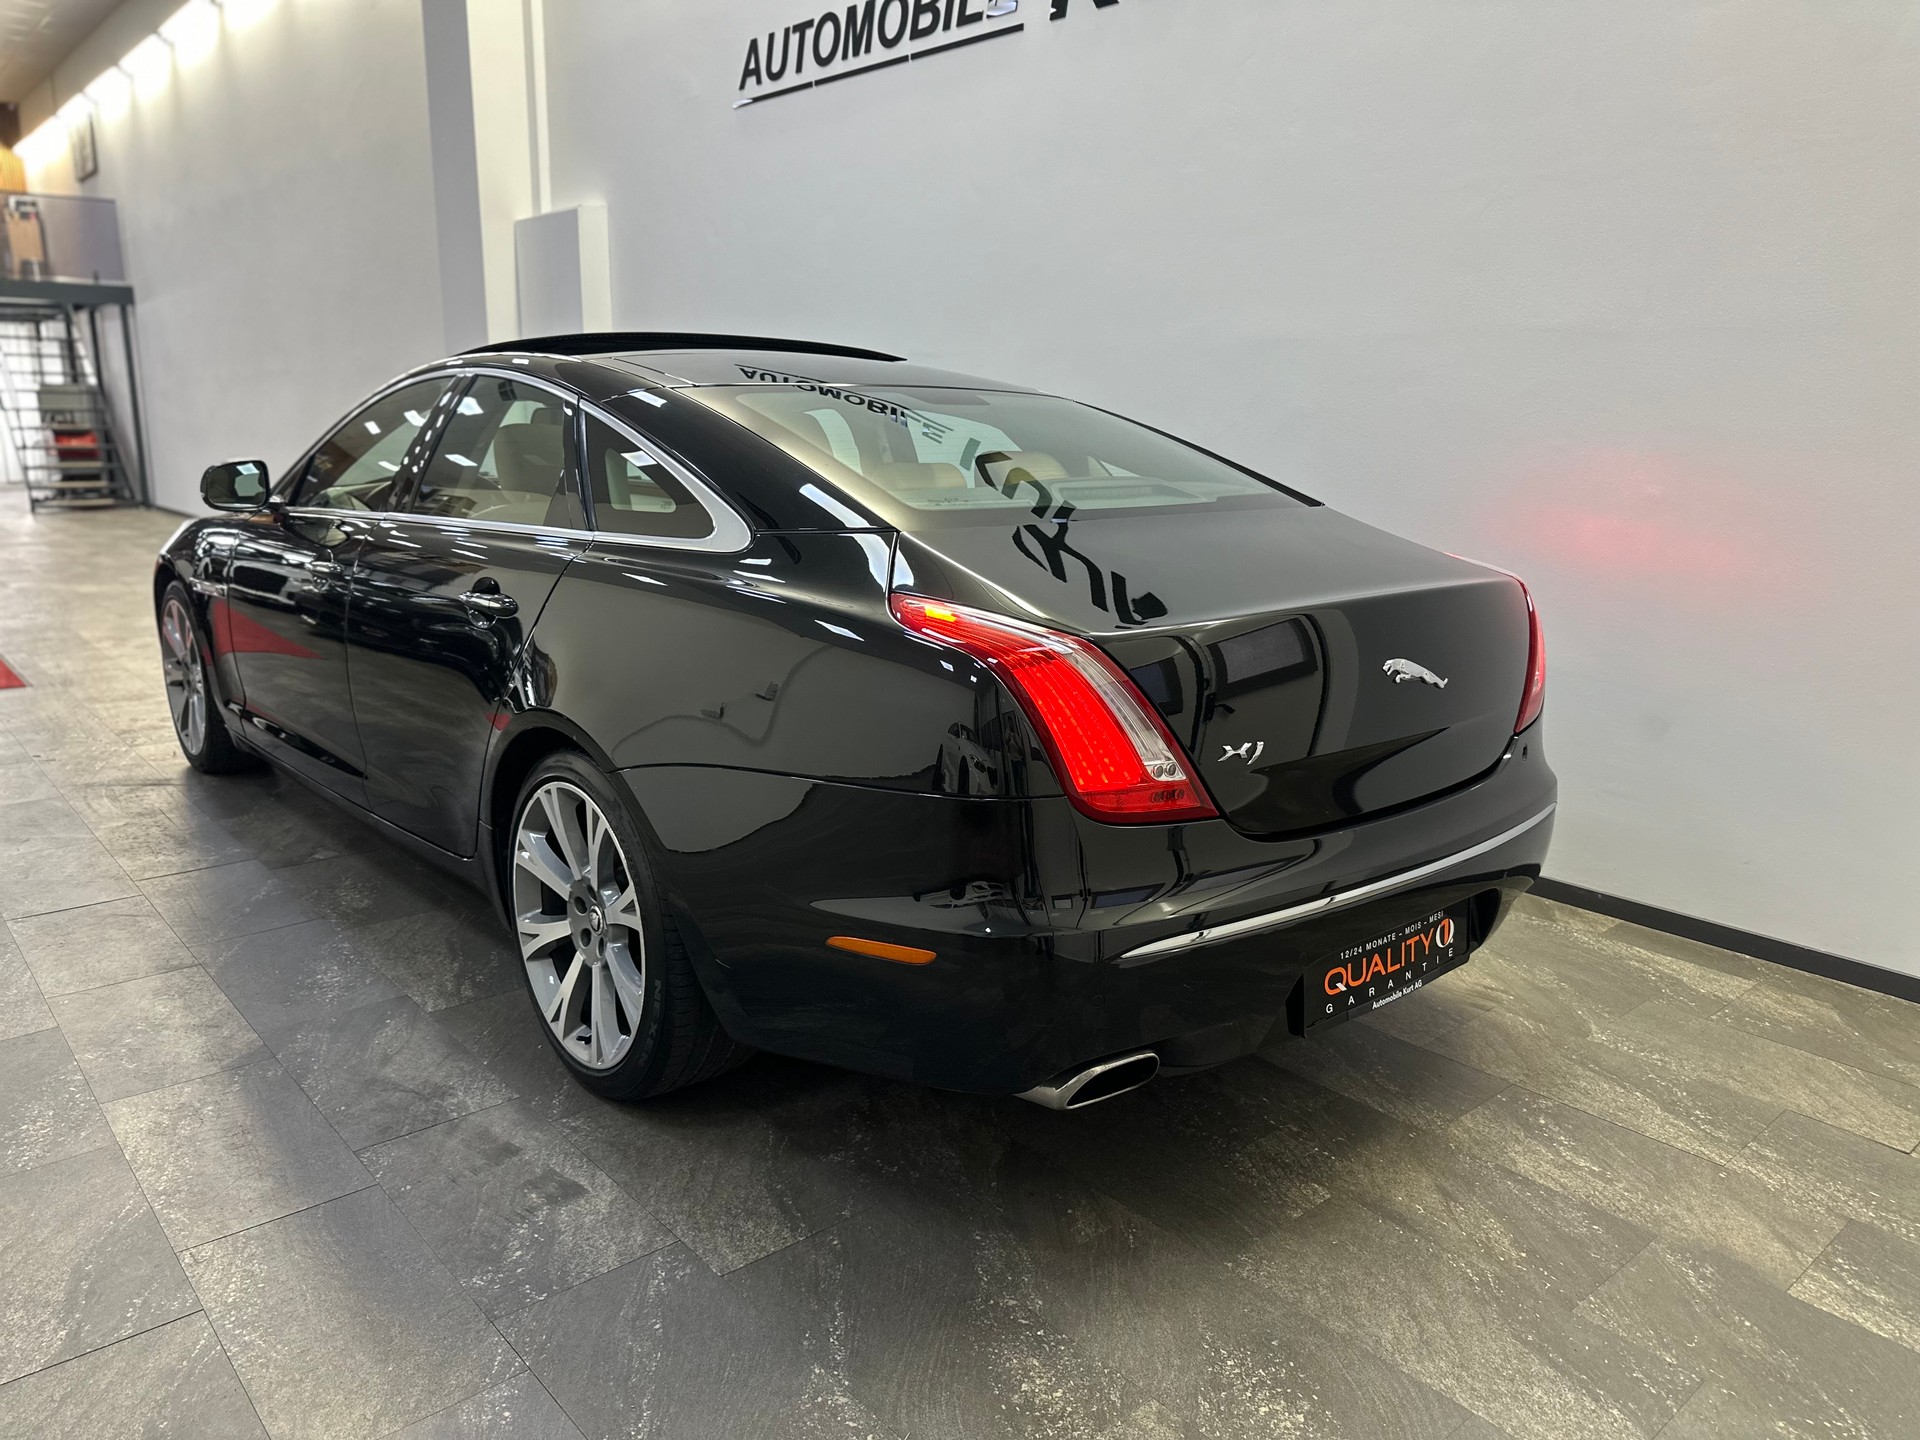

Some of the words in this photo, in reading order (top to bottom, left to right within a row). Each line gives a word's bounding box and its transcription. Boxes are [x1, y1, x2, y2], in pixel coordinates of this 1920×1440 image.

[1217, 741, 1264, 766] XJ
[1340, 945, 1363, 960] 12/24
[1365, 932, 1396, 951] MONATE
[1405, 921, 1422, 935] MOIS
[1429, 910, 1444, 924] MESI
[1372, 990, 1403, 1010] Automobile
[1402, 984, 1414, 996] Kurt
[1414, 979, 1423, 990] AG
